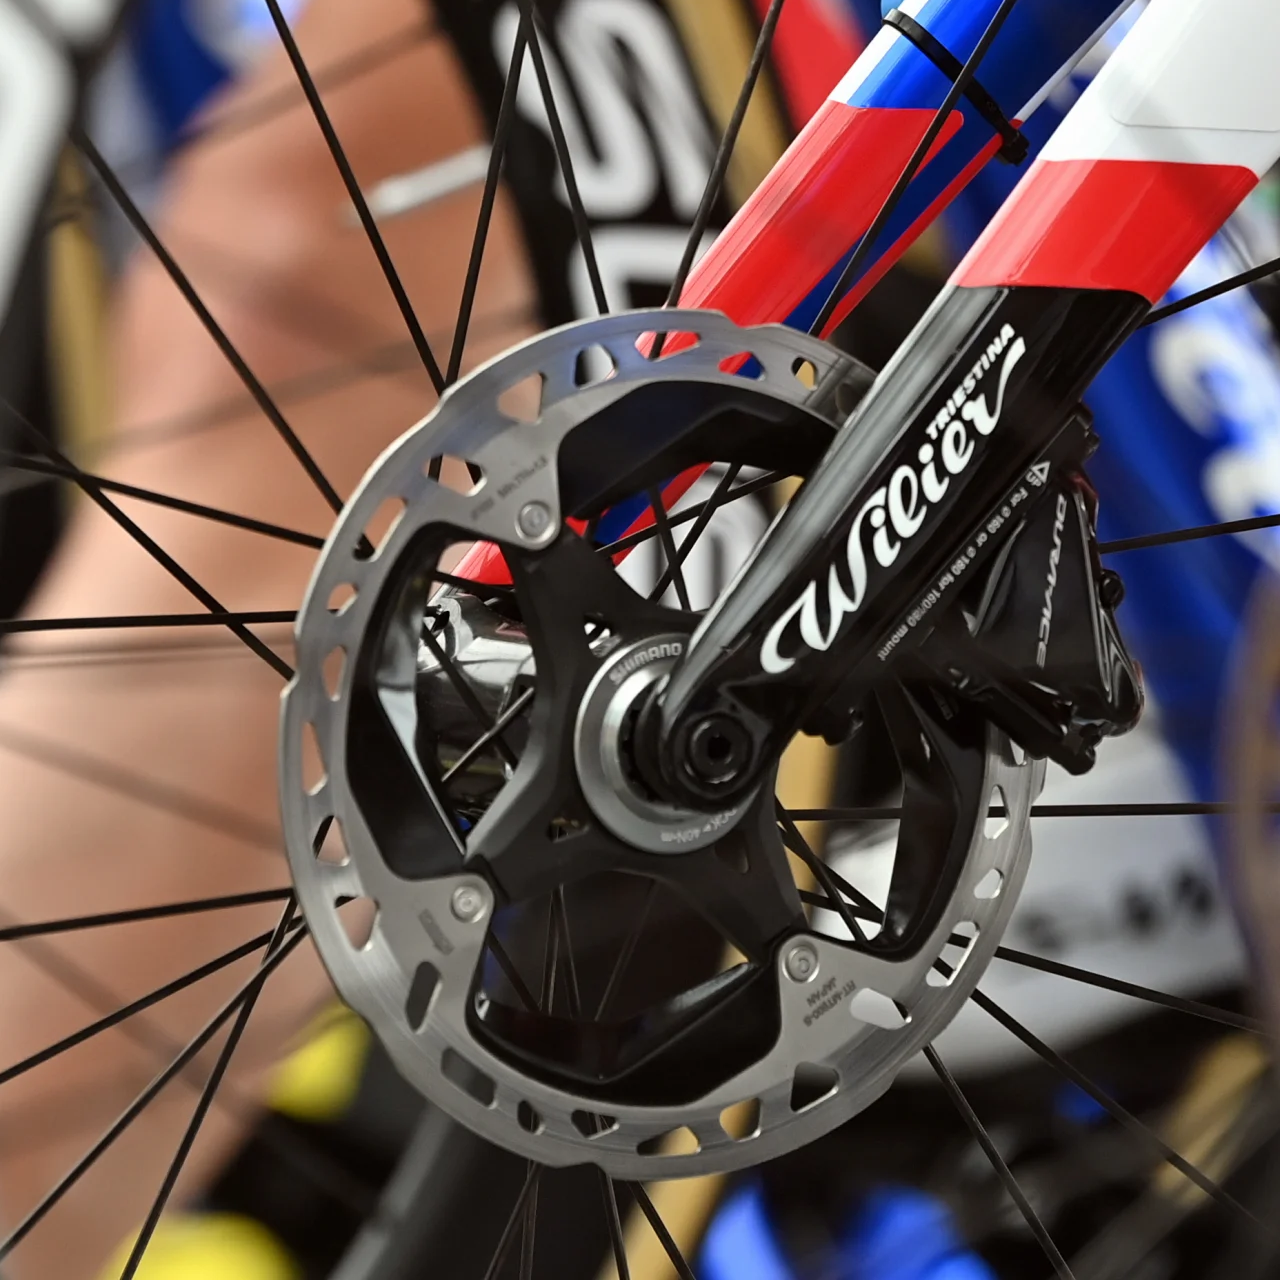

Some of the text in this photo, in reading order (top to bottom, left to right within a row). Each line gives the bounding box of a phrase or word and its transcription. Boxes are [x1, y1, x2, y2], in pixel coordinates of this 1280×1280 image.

[925, 323, 1016, 440] TRIESTINA
[759, 336, 1026, 674] Wilier
[609, 642, 682, 686] SHIMANO
